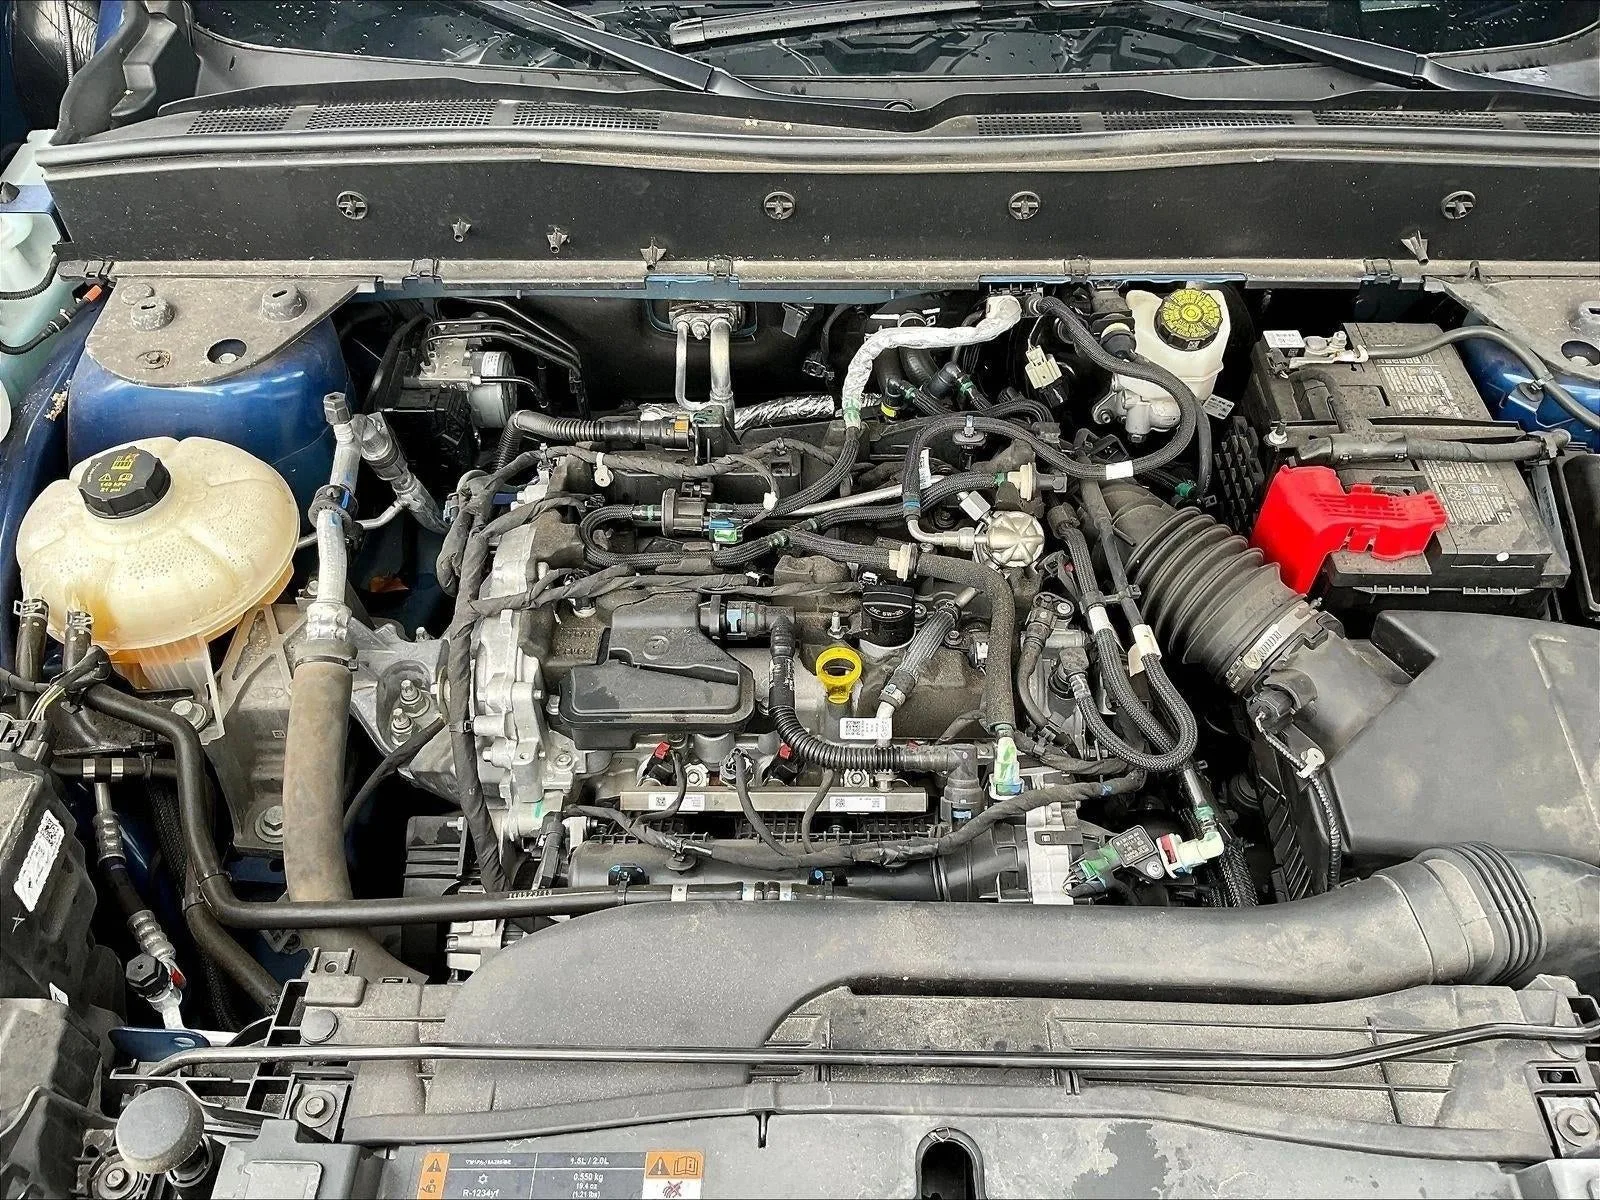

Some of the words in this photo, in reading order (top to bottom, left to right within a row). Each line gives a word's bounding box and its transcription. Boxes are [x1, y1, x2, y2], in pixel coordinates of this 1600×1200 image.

[592, 1156, 610, 1165] 2.0L
[573, 1172, 593, 1181] 0.550
[594, 1172, 604, 1183] kg
